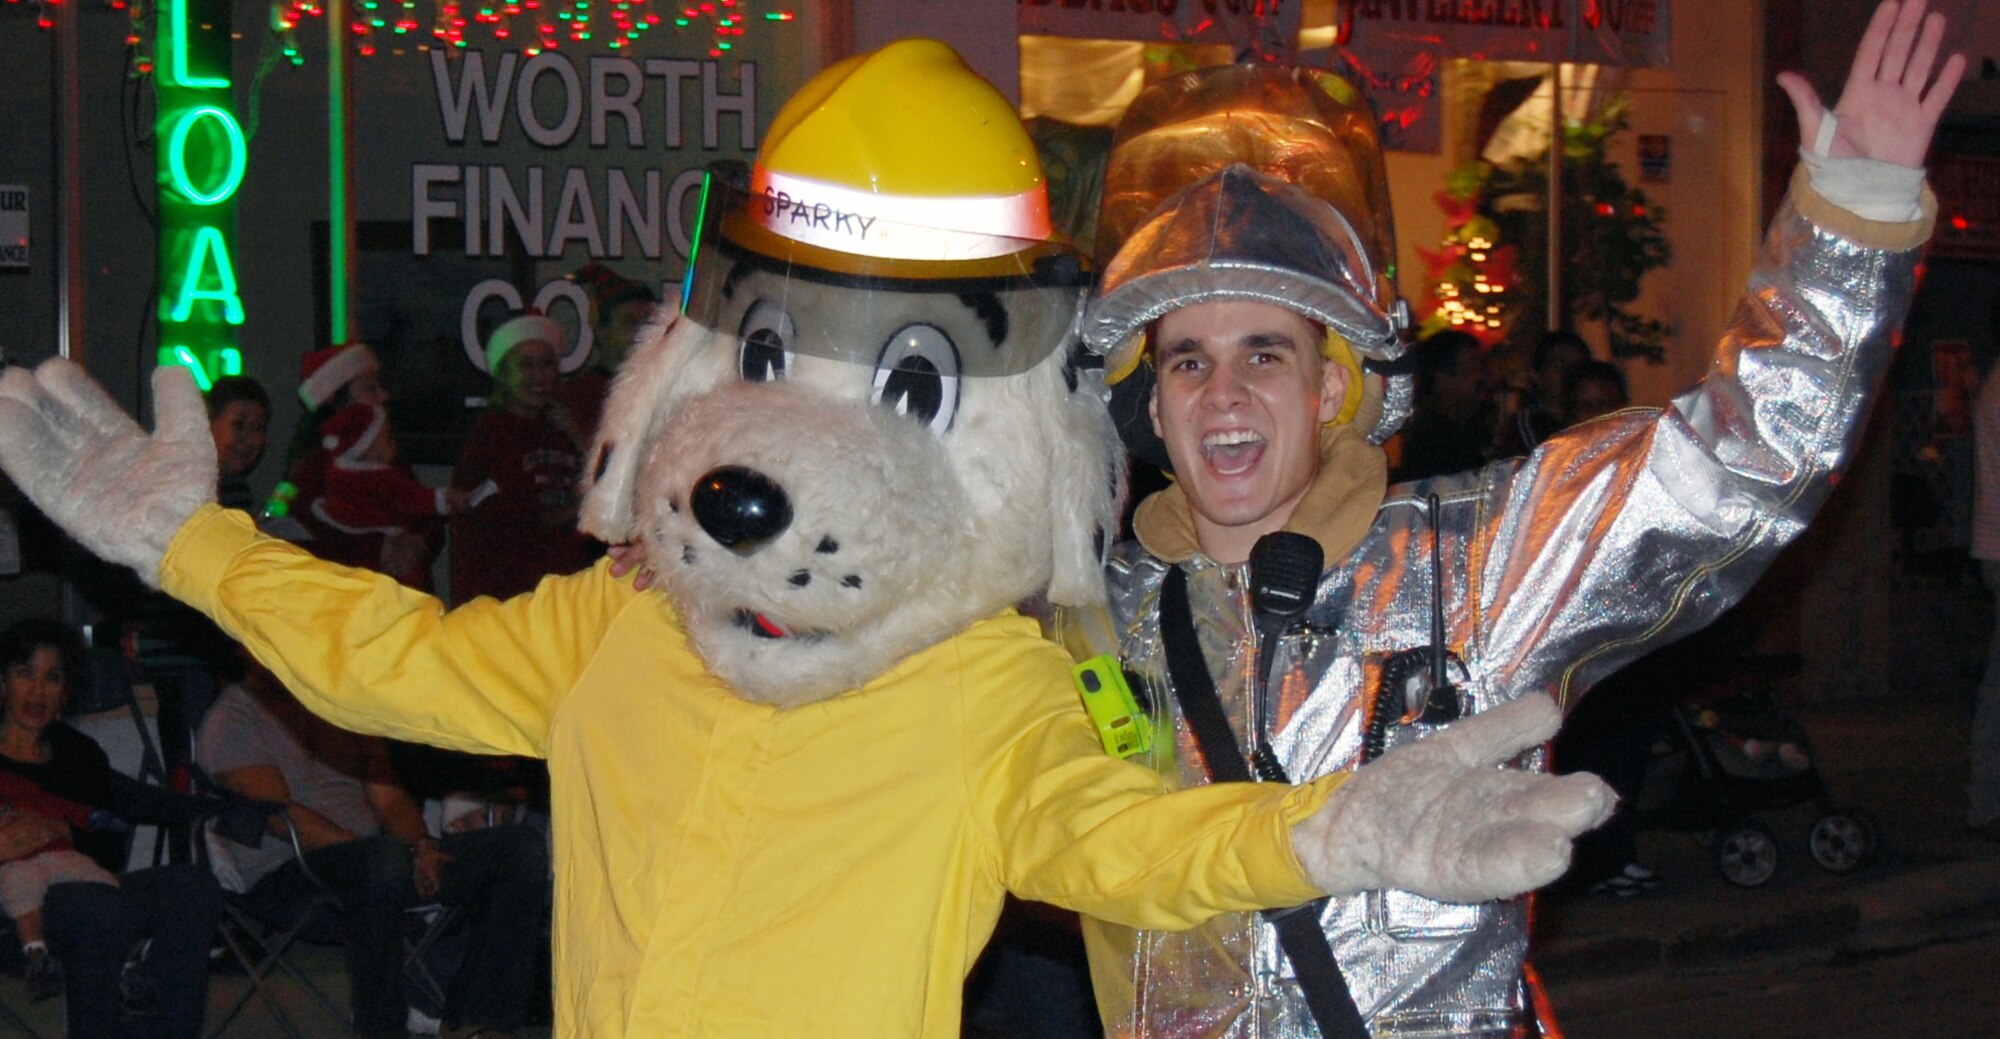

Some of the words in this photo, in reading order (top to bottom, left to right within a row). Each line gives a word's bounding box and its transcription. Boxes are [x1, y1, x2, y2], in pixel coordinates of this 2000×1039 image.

[430, 49, 756, 150] WORTH
[413, 164, 711, 259] FINANC
[763, 185, 877, 240] SPARKY
